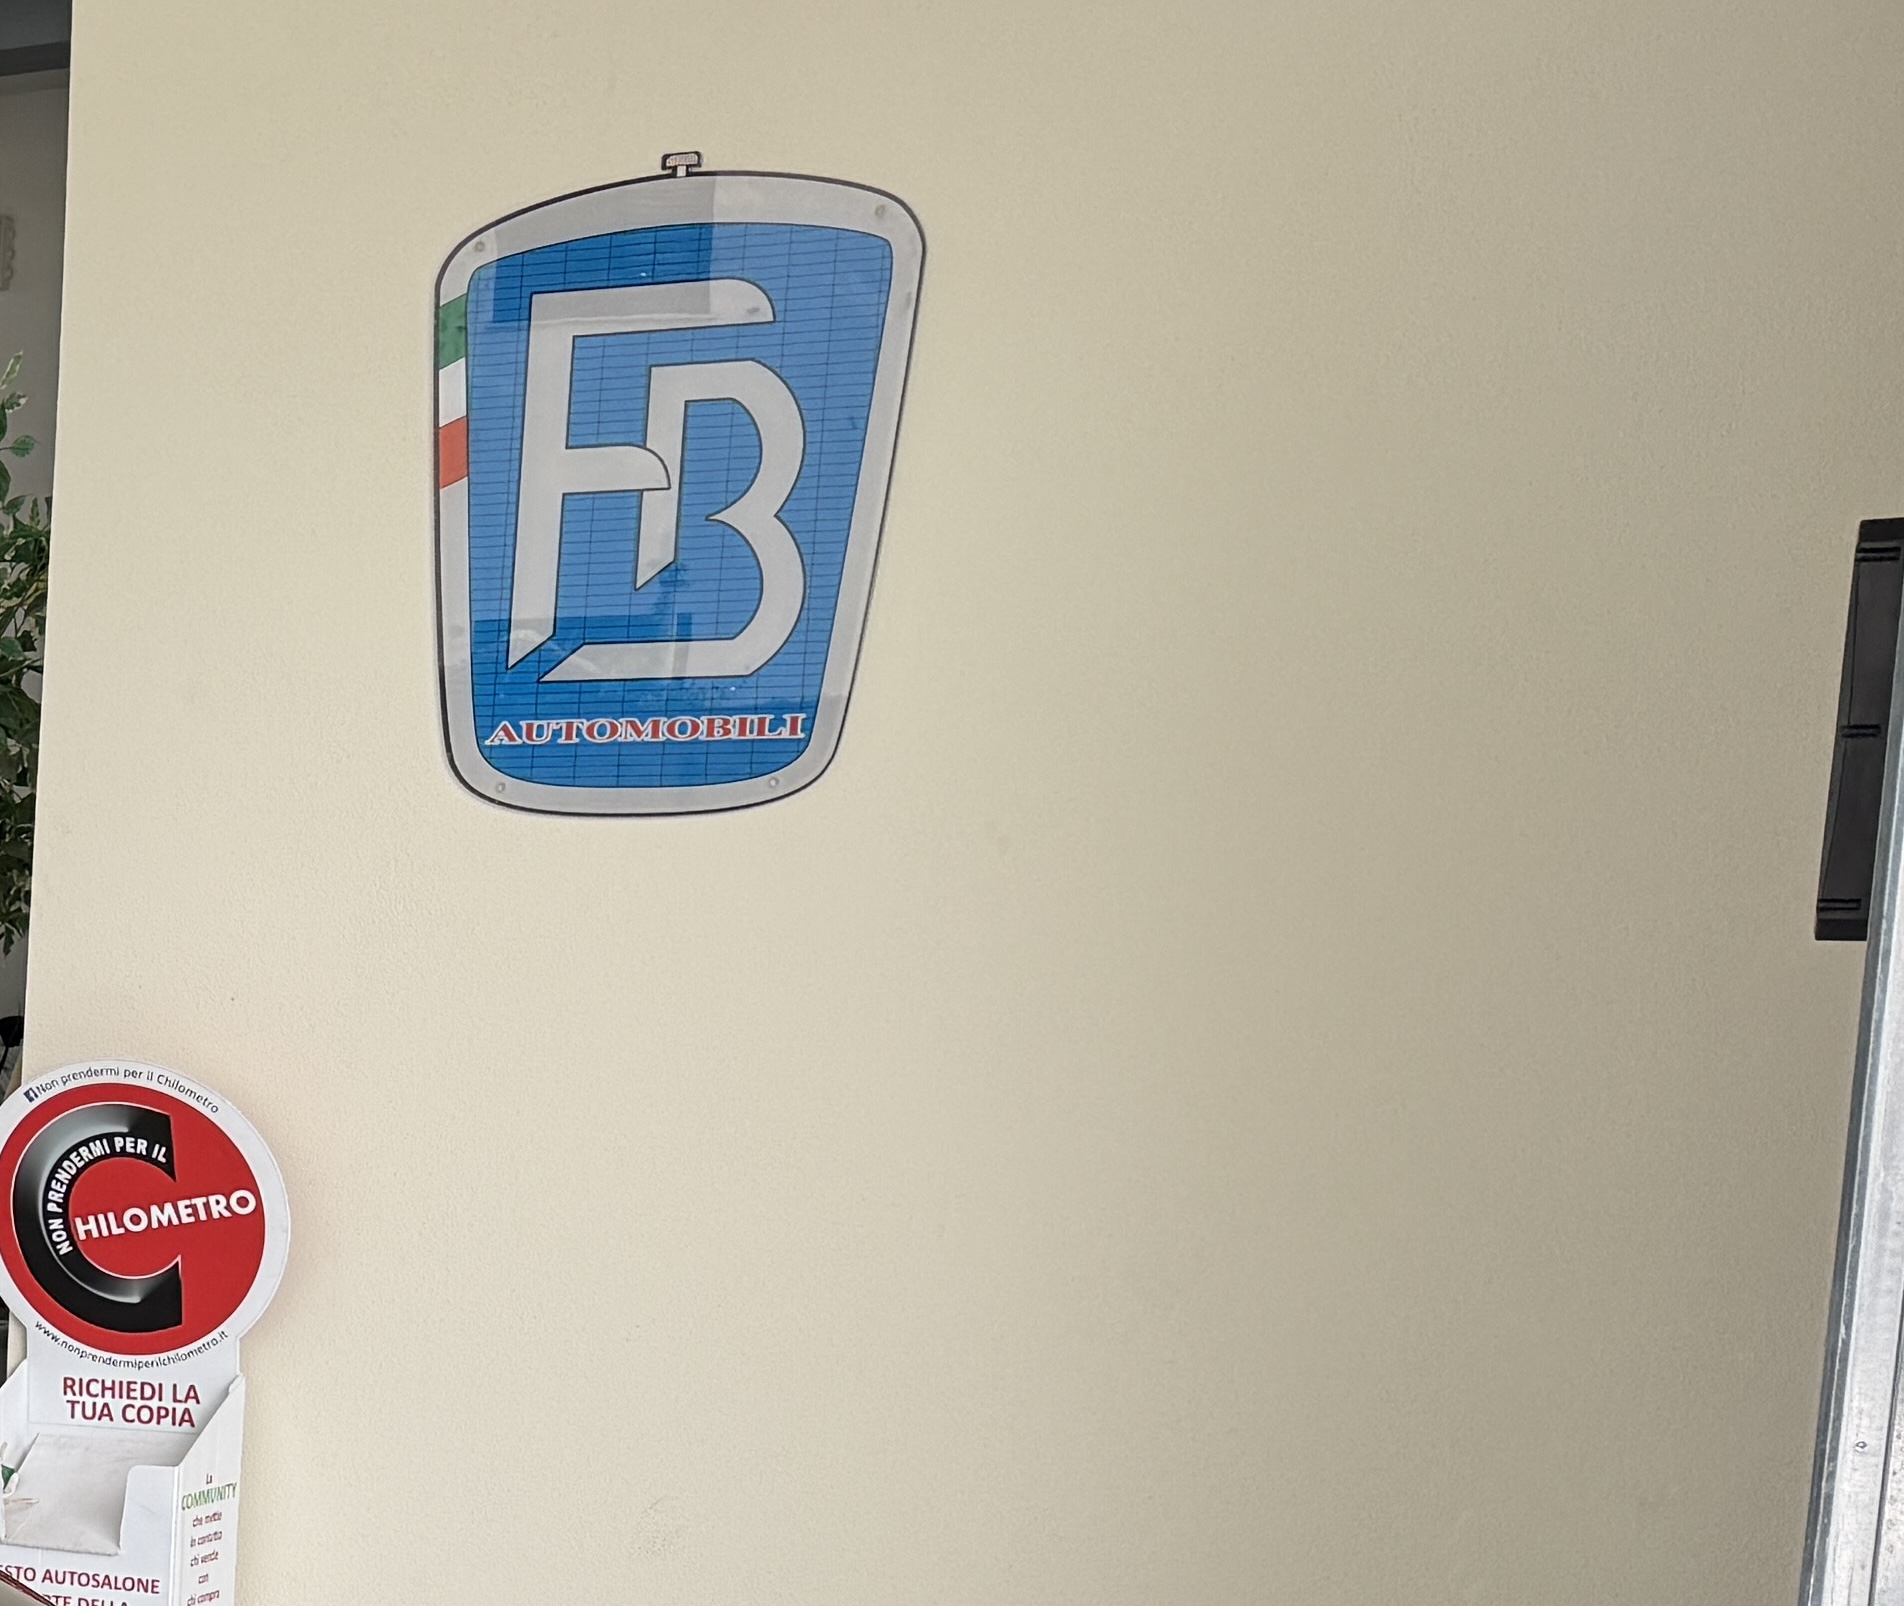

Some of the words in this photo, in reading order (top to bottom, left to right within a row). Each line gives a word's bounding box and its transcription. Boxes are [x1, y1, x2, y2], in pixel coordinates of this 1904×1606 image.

[485, 713, 806, 746] AUTOMOBILI
[35, 1079, 60, 1095] Non
[60, 1066, 120, 1087] prendermi
[123, 1068, 143, 1079] per
[146, 1070, 154, 1081] il
[156, 1073, 219, 1114] Chilometro
[113, 1136, 148, 1156] PER
[151, 1143, 167, 1163] IL
[46, 1138, 111, 1213] PRENDERMI
[48, 1218, 73, 1256] NON
[62, 1376, 164, 1402] RICHIEDI
[172, 1383, 201, 1405] LA
[66, 1399, 114, 1422] TUA
[121, 1403, 196, 1428] COPIA
[181, 1482, 237, 1511] COMMUNITY
[41, 1568, 161, 1595] AUTOSALONE
